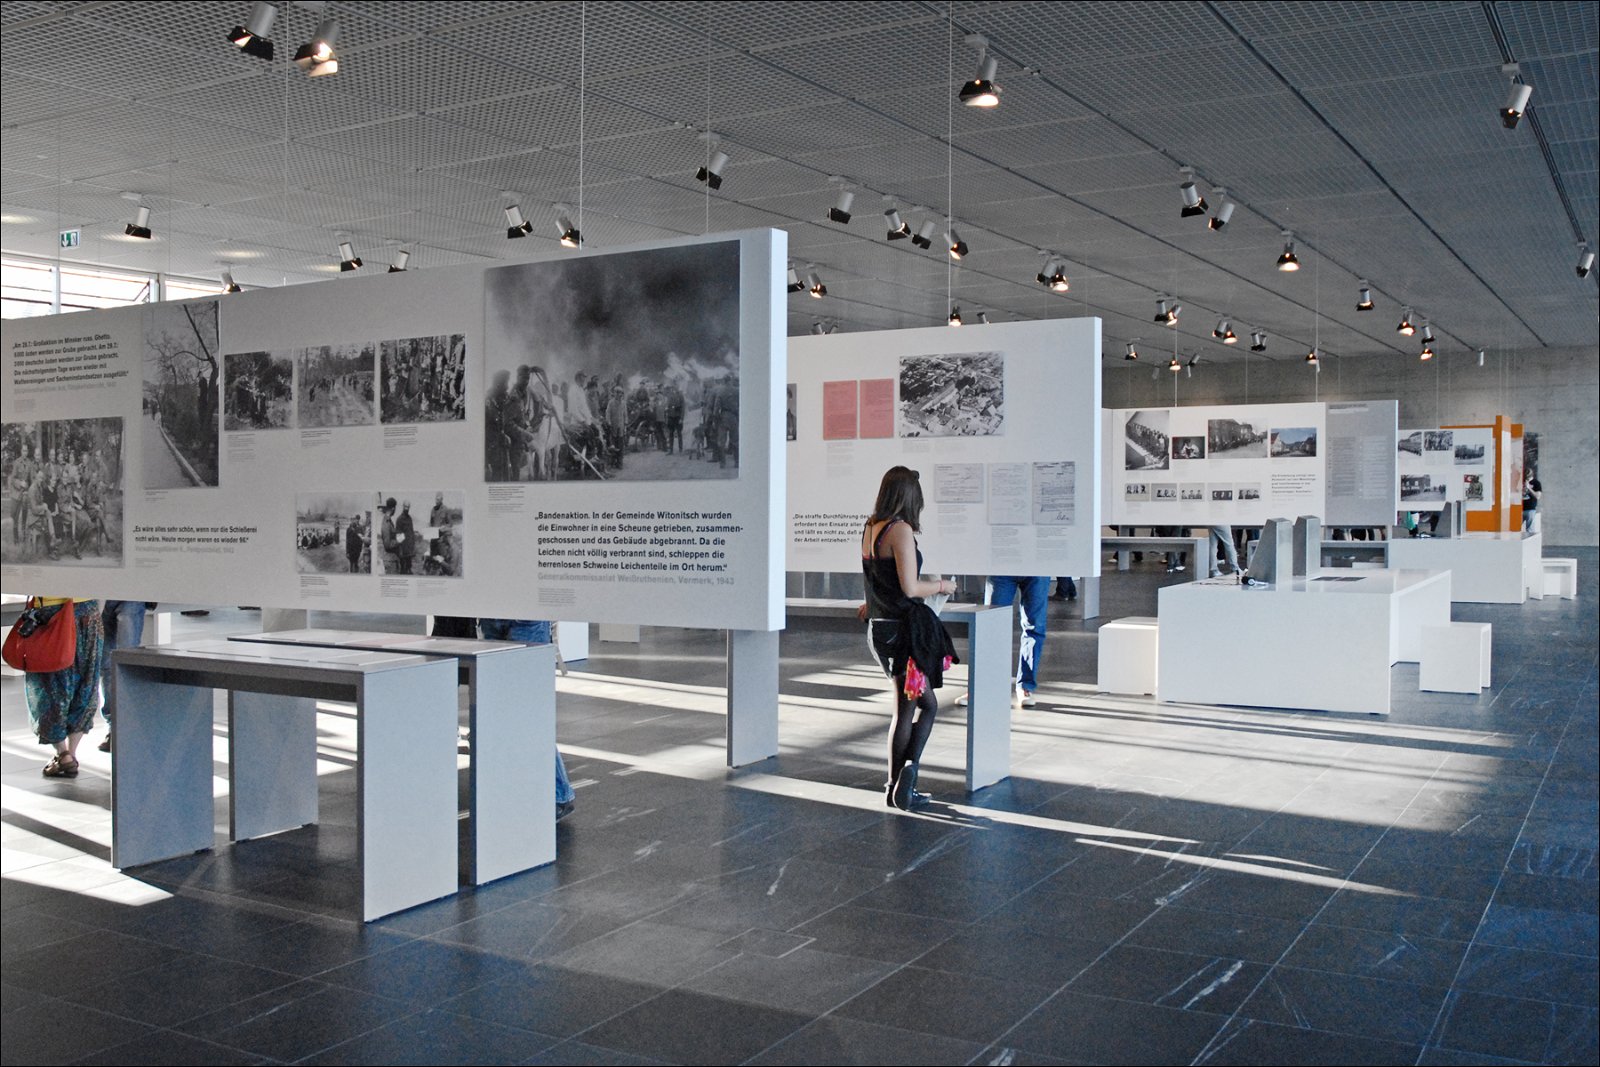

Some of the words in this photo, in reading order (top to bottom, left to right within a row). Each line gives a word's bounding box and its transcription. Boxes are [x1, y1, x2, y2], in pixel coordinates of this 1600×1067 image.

[616, 511, 655, 519] Gemeinde
[657, 511, 699, 519] Witonitsch
[701, 511, 732, 519] wurden
[551, 524, 589, 532] Einwohner
[600, 524, 616, 532] eine
[618, 524, 651, 532] Scheune
[653, 524, 694, 534] getrieben,
[537, 536, 580, 545] geschossen
[613, 536, 647, 545] Gebäude
[649, 537, 697, 547] abgebrannt.
[699, 537, 710, 545] Da
[712, 537, 725, 545] die
[538, 548, 565, 556] Leichen
[587, 549, 607, 558] völlig
[609, 549, 646, 557] verbrannt
[648, 550, 667, 558] sind,
[669, 550, 709, 560] schleppen
[712, 550, 725, 559] die
[538, 560, 581, 568] herrenlosen
[583, 561, 619, 569] Schweine
[621, 562, 667, 571] Leichenteile
[681, 563, 694, 571] Ort
